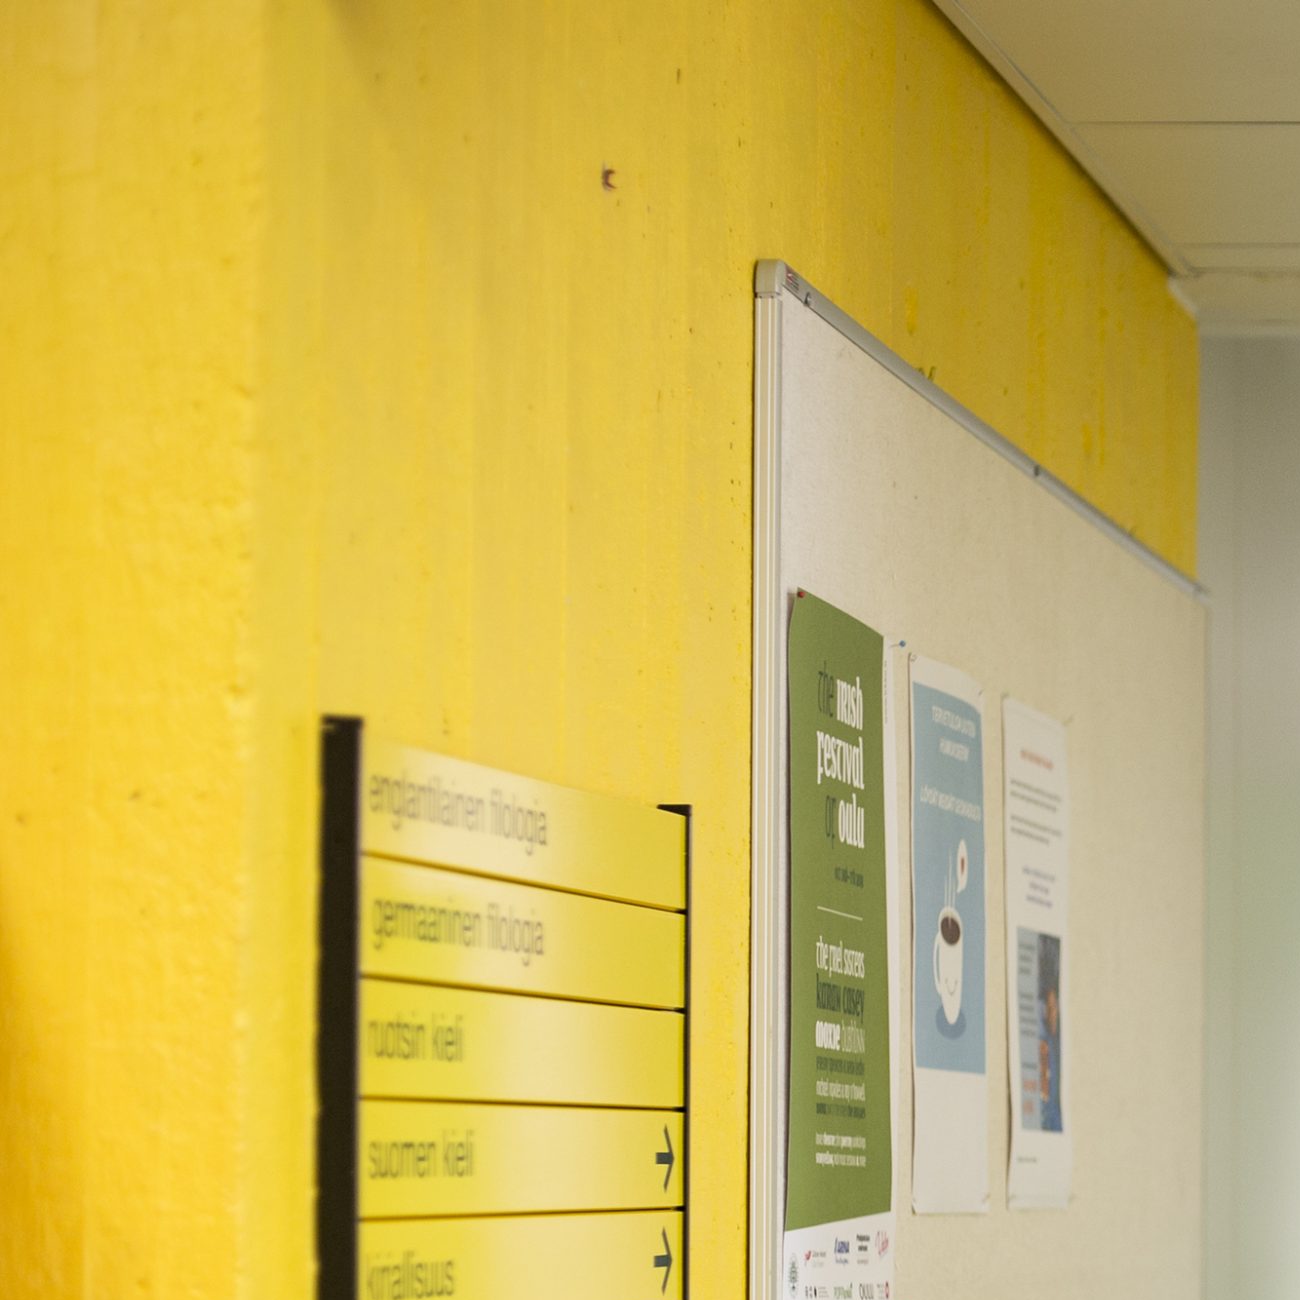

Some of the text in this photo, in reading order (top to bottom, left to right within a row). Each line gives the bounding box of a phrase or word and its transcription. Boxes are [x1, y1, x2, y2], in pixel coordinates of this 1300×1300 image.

[368, 767, 549, 855] englantilainen filologia
[838, 793, 865, 849] oulu
[372, 895, 545, 966] germaaninen filologia
[367, 1013, 464, 1062] ruotsin kieli
[367, 1129, 475, 1180] suomen kieli
